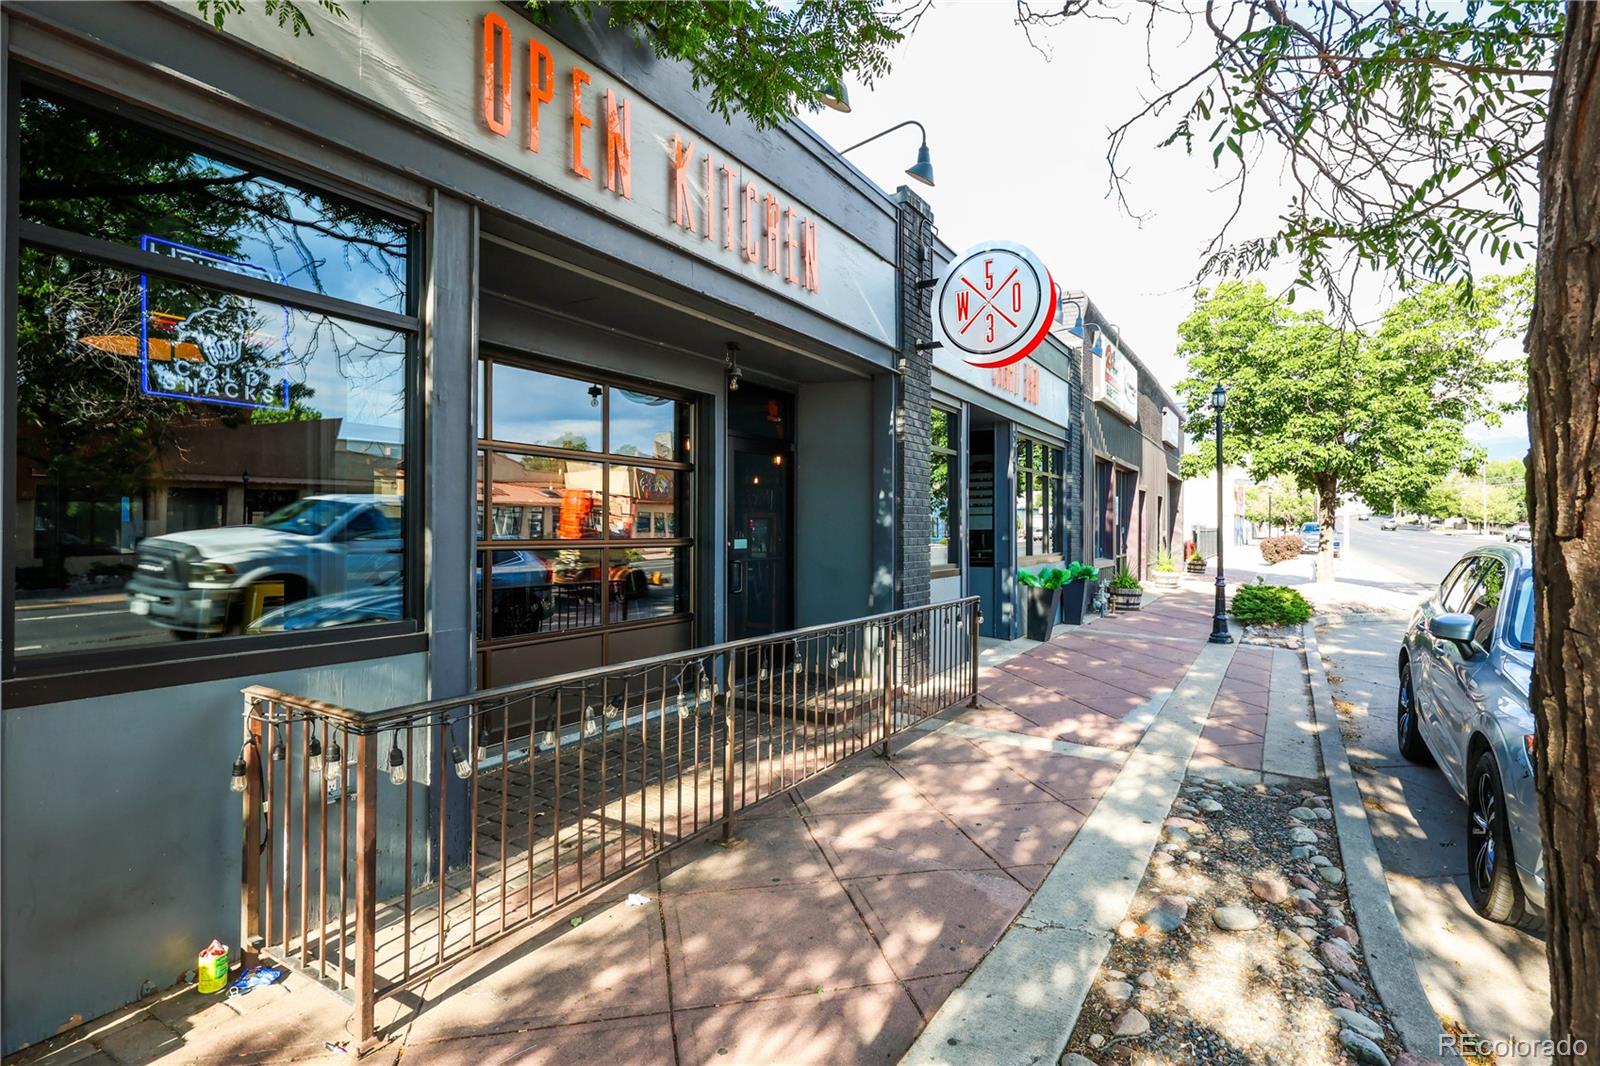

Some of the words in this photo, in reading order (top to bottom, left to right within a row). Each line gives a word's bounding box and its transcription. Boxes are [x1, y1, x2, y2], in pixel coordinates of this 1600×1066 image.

[483, 11, 632, 200] OPEN
[672, 133, 820, 294] KITCHEN
[985, 259, 994, 291] 5
[956, 291, 969, 322] W
[986, 313, 994, 343] 3
[162, 376, 274, 403] SNACKS
